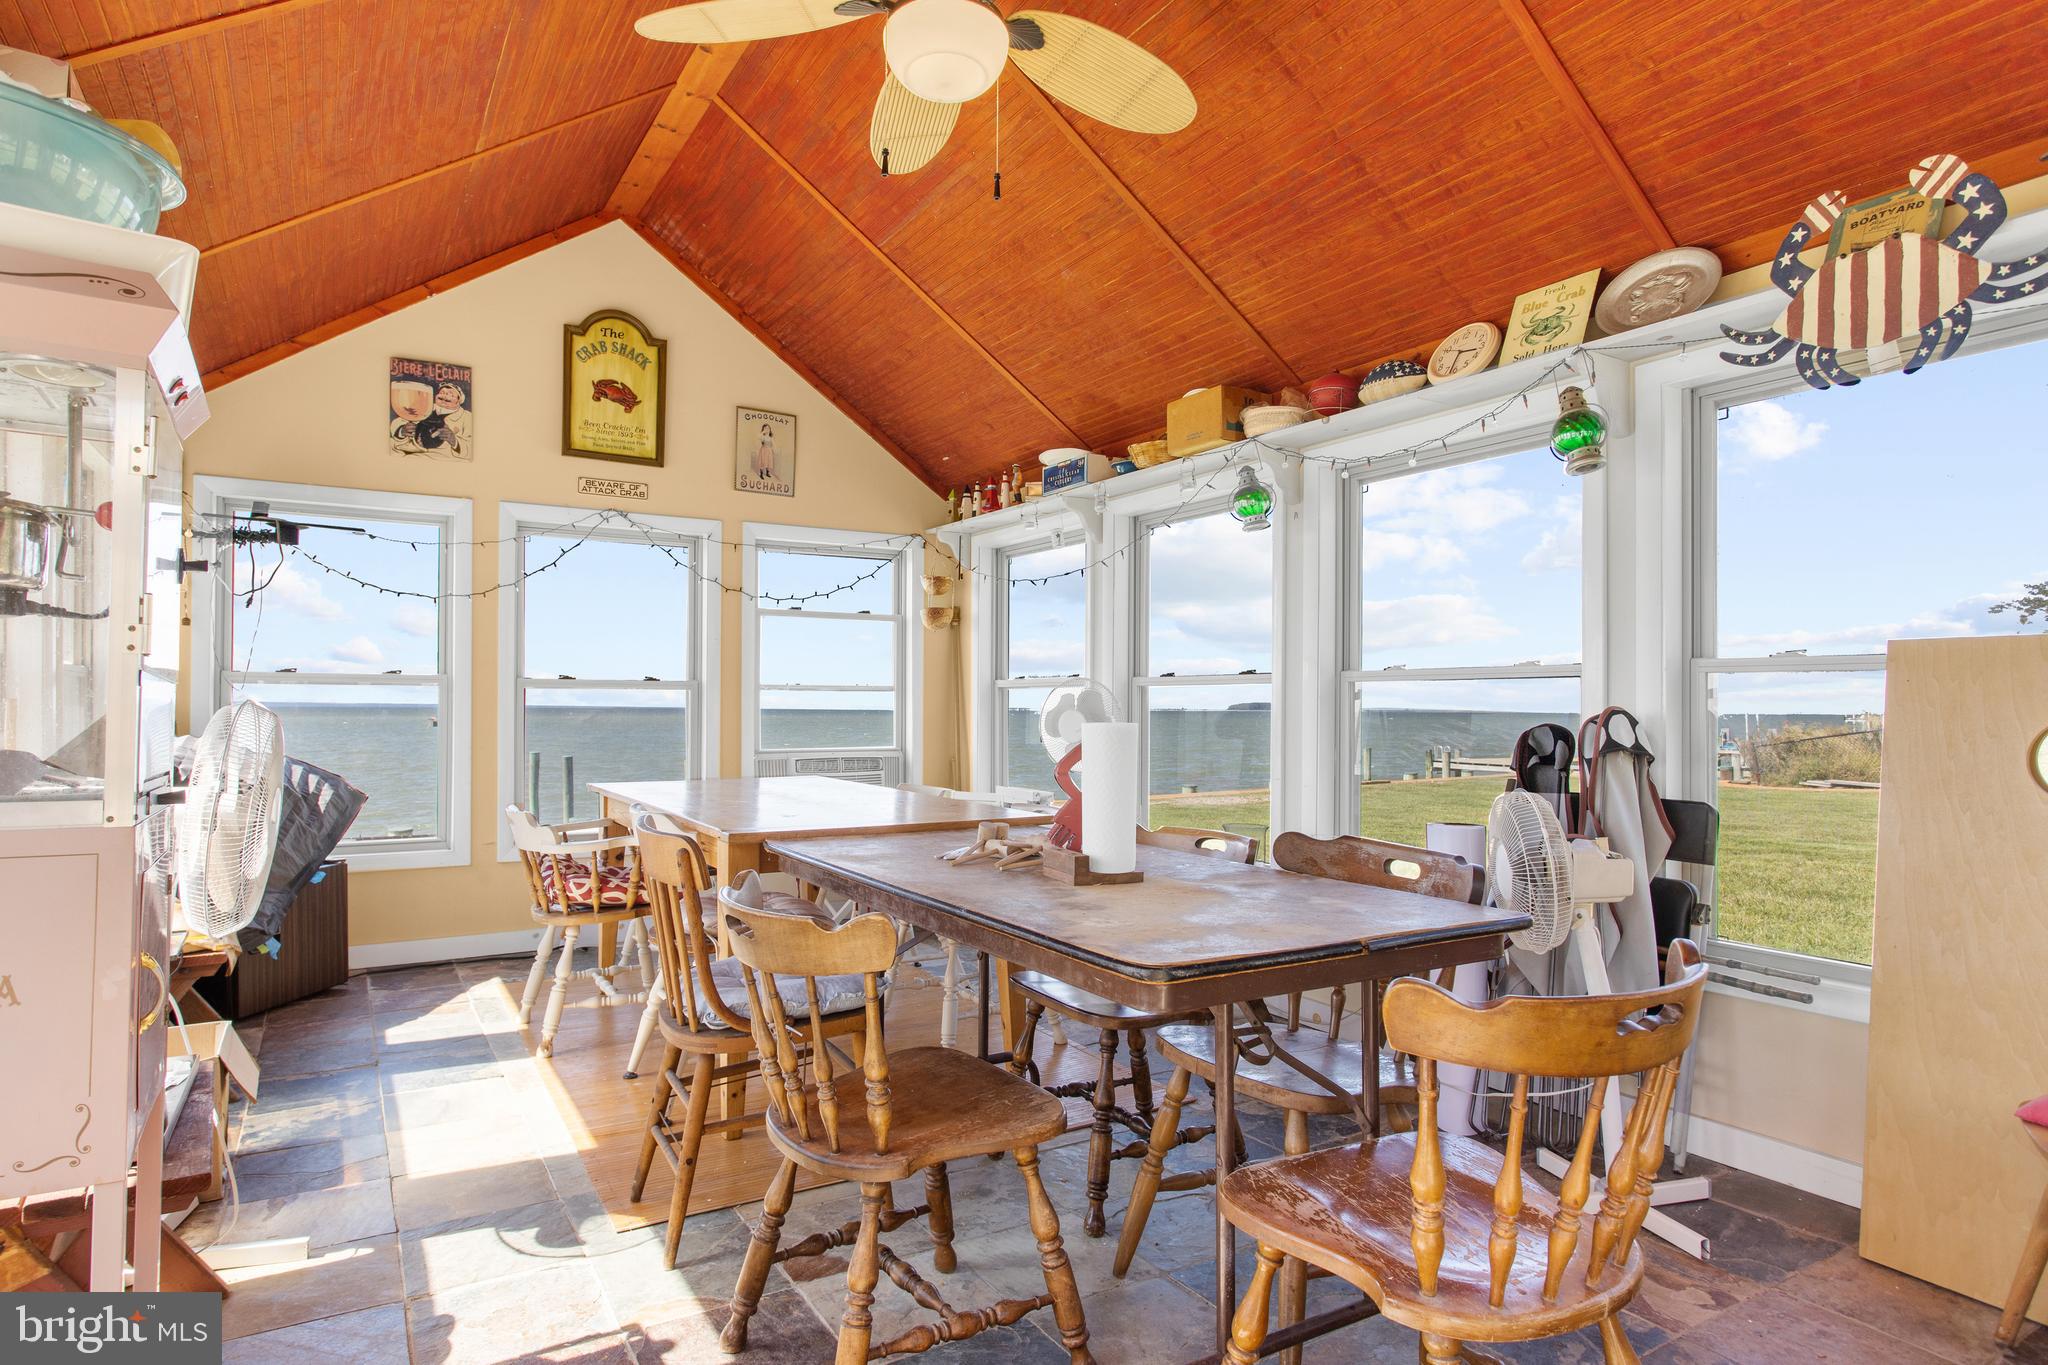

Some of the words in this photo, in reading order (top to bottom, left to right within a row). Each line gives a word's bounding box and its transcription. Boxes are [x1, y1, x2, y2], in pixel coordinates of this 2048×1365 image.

[1850, 200, 1925, 230] BOATYARD
[1544, 284, 1567, 296] Fresh
[1521, 300, 1549, 315] Blue
[1556, 285, 1587, 304] Crab
[600, 327, 625, 339] The
[575, 340, 608, 363] CRAB
[611, 341, 652, 370] SHACK
[1512, 350, 1536, 362] Sold
[1543, 342, 1569, 354] Here
[744, 413, 790, 425] CHOCOLAT
[595, 427, 615, 437] Since
[585, 479, 625, 490] BEWARE
[740, 474, 790, 494] SUCHARD
[581, 485, 616, 496] ATTACK
[620, 489, 646, 498] CRAB
